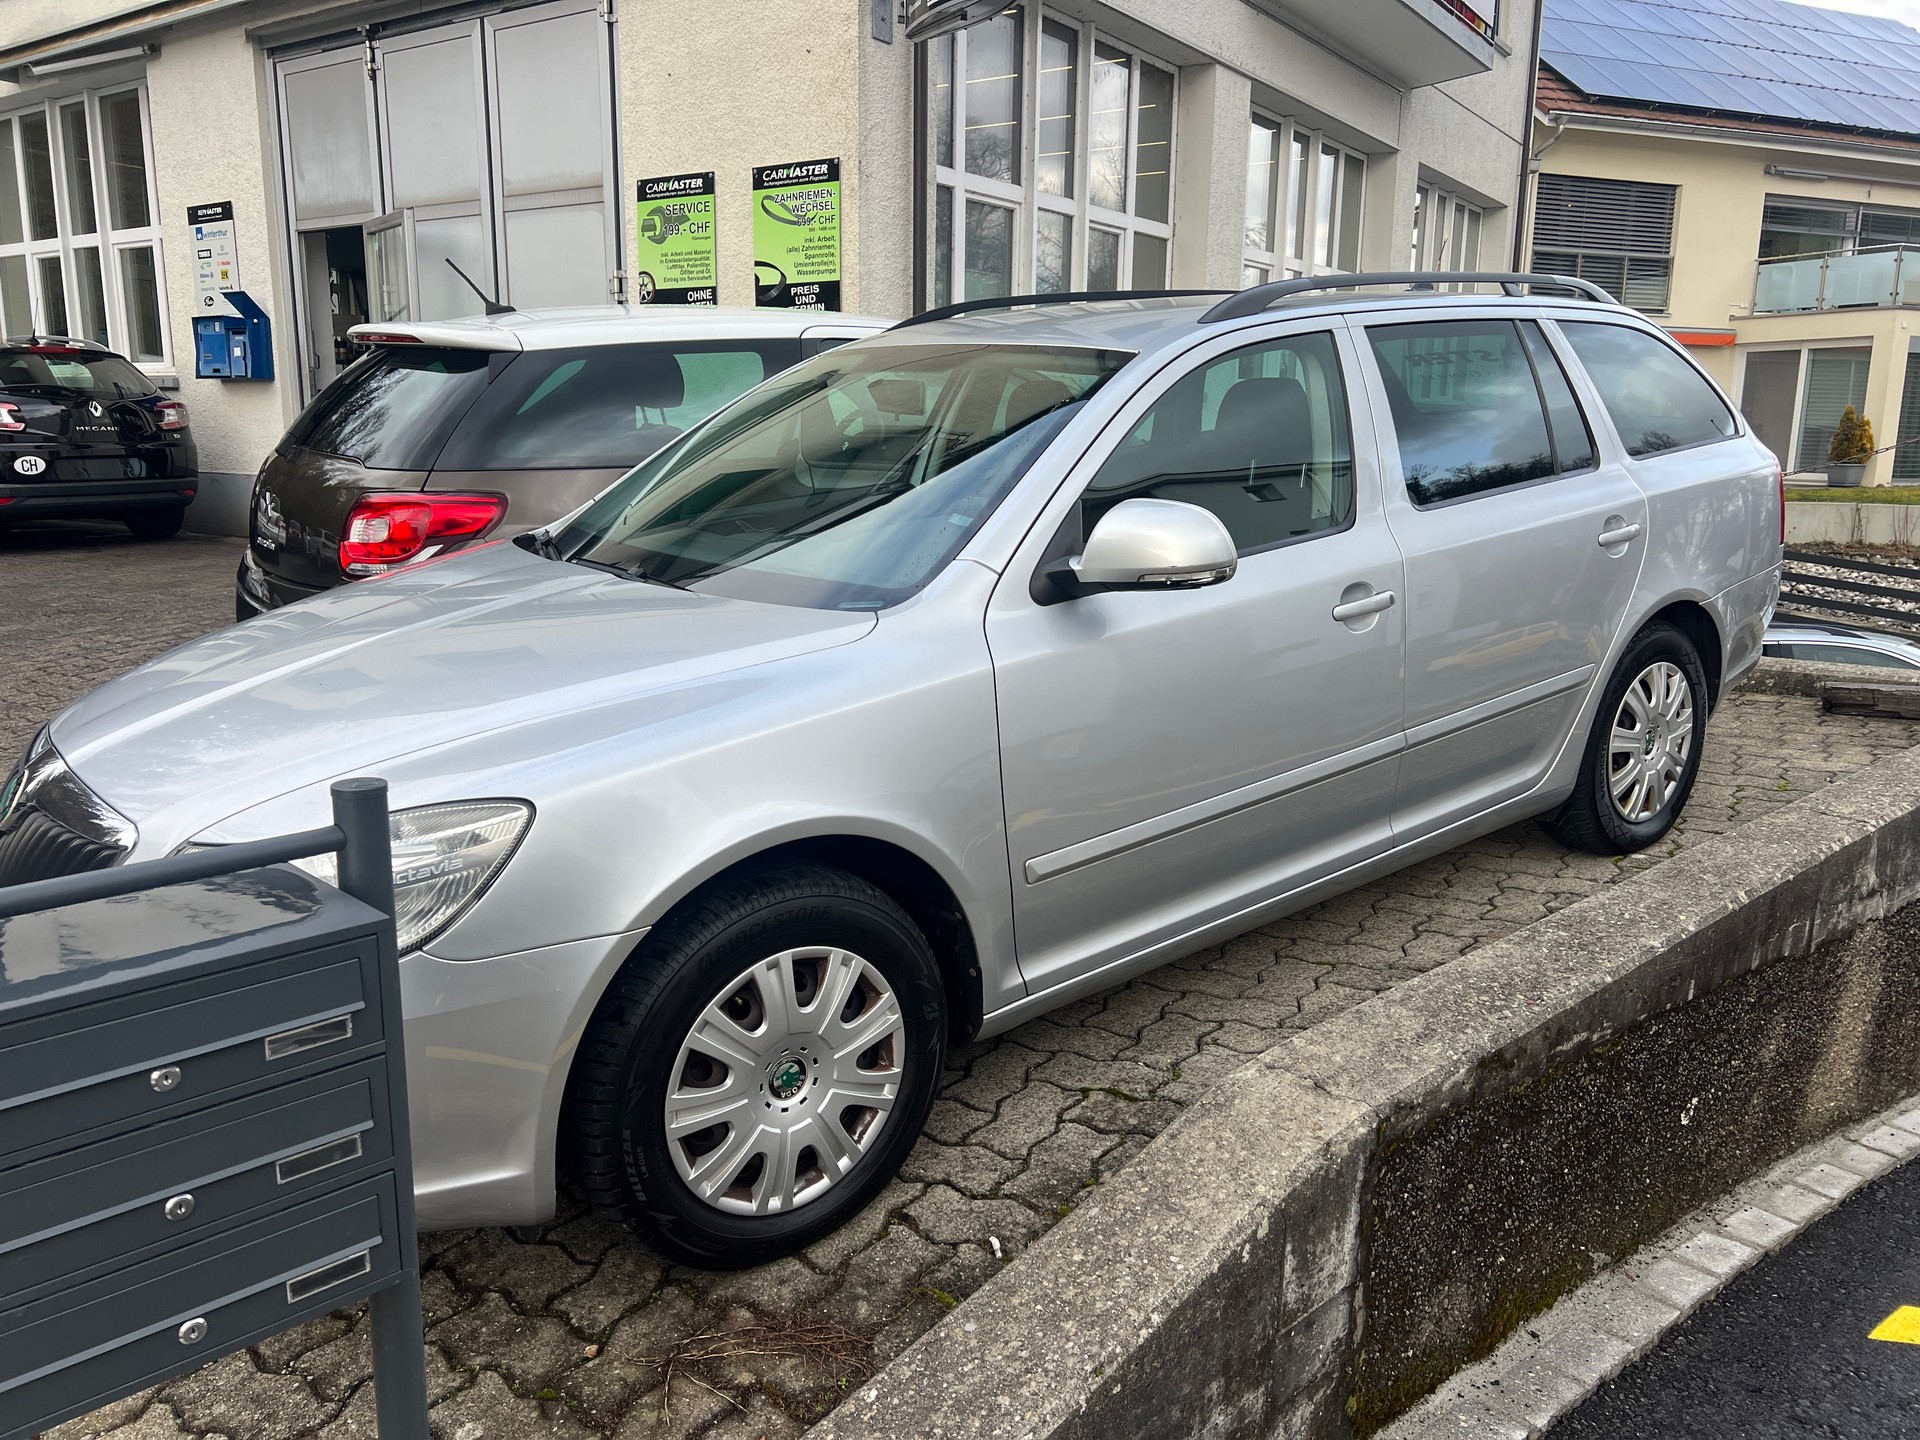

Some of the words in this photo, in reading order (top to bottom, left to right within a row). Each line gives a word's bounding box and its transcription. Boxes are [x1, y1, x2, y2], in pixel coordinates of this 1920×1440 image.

[762, 164, 828, 181] CARMASTER
[646, 178, 703, 194] CARMASTER
[774, 188, 836, 204] ZAHNRIEMEN-
[665, 201, 711, 216] SERVICE
[791, 201, 836, 214] WECHSEL
[818, 215, 836, 225] CHF
[663, 223, 687, 237] 199,-
[689, 222, 711, 234] CHF
[786, 246, 800, 254] (alle)
[801, 243, 836, 252] Zahnriemen,
[804, 251, 836, 260] Spannrolle,
[793, 260, 836, 268] Umlenkrolle(n),
[796, 268, 837, 276] Wasserpumpe
[687, 288, 713, 302] OHNE
[790, 284, 820, 296] PREIS
[795, 294, 816, 305] UND
[21, 459, 39, 473] CH
[392, 857, 464, 885] ctavia
[622, 1127, 648, 1201] BLIZZAK
